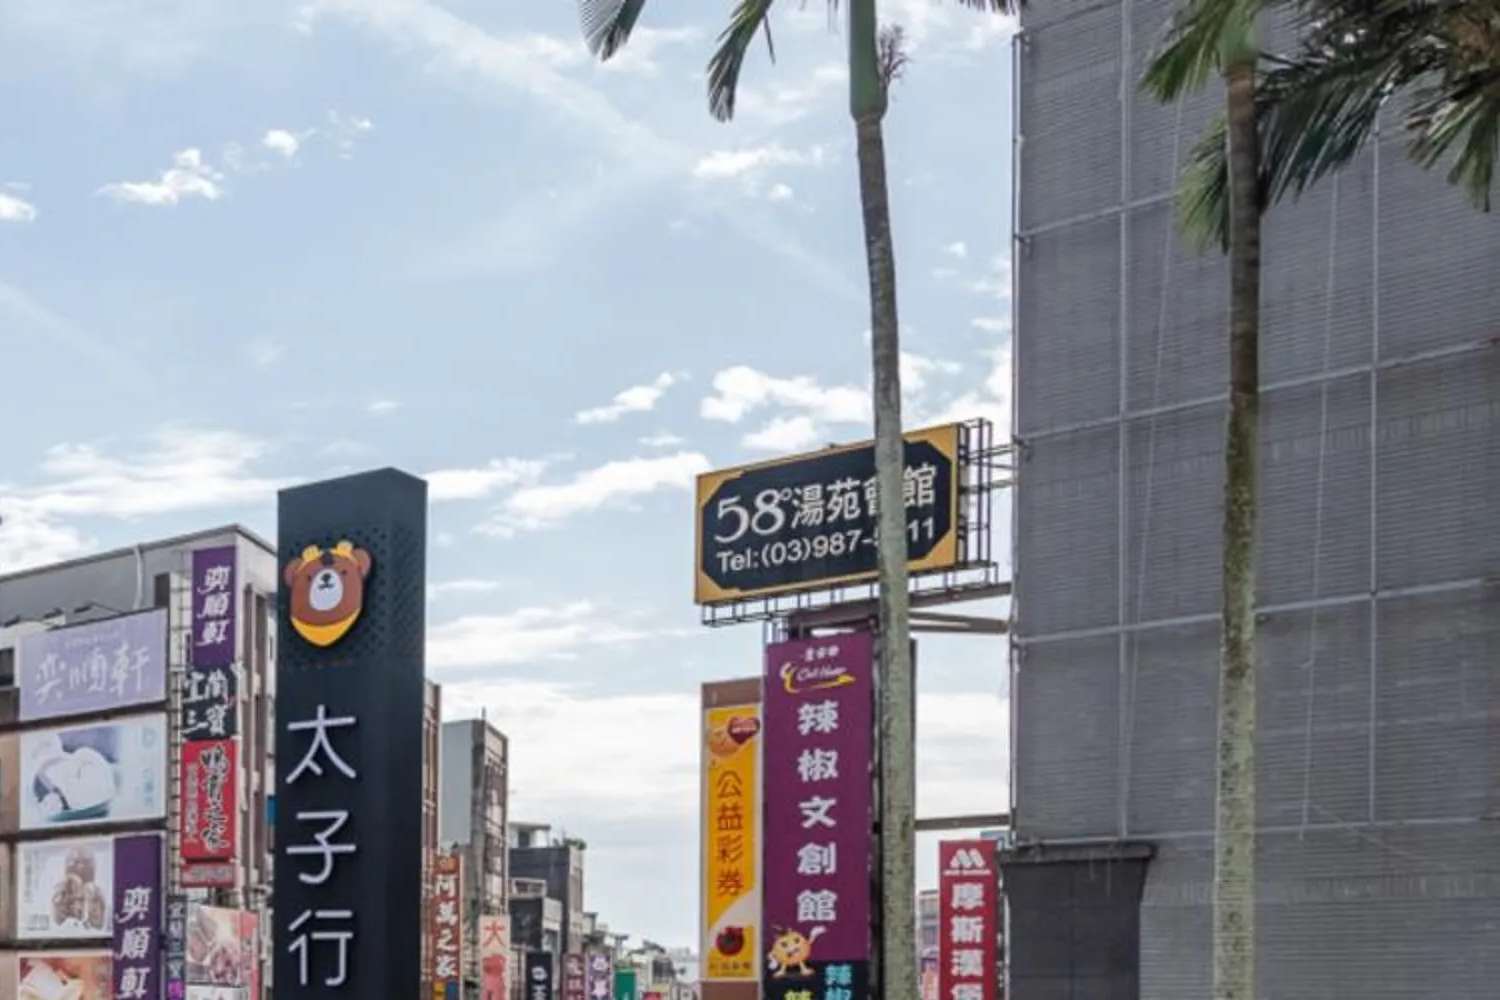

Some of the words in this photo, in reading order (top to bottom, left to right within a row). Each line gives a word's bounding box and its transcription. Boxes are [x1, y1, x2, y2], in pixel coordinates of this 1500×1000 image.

[716, 769, 744, 898] 公益彩券
[797, 700, 839, 922] 辣椒文創館
